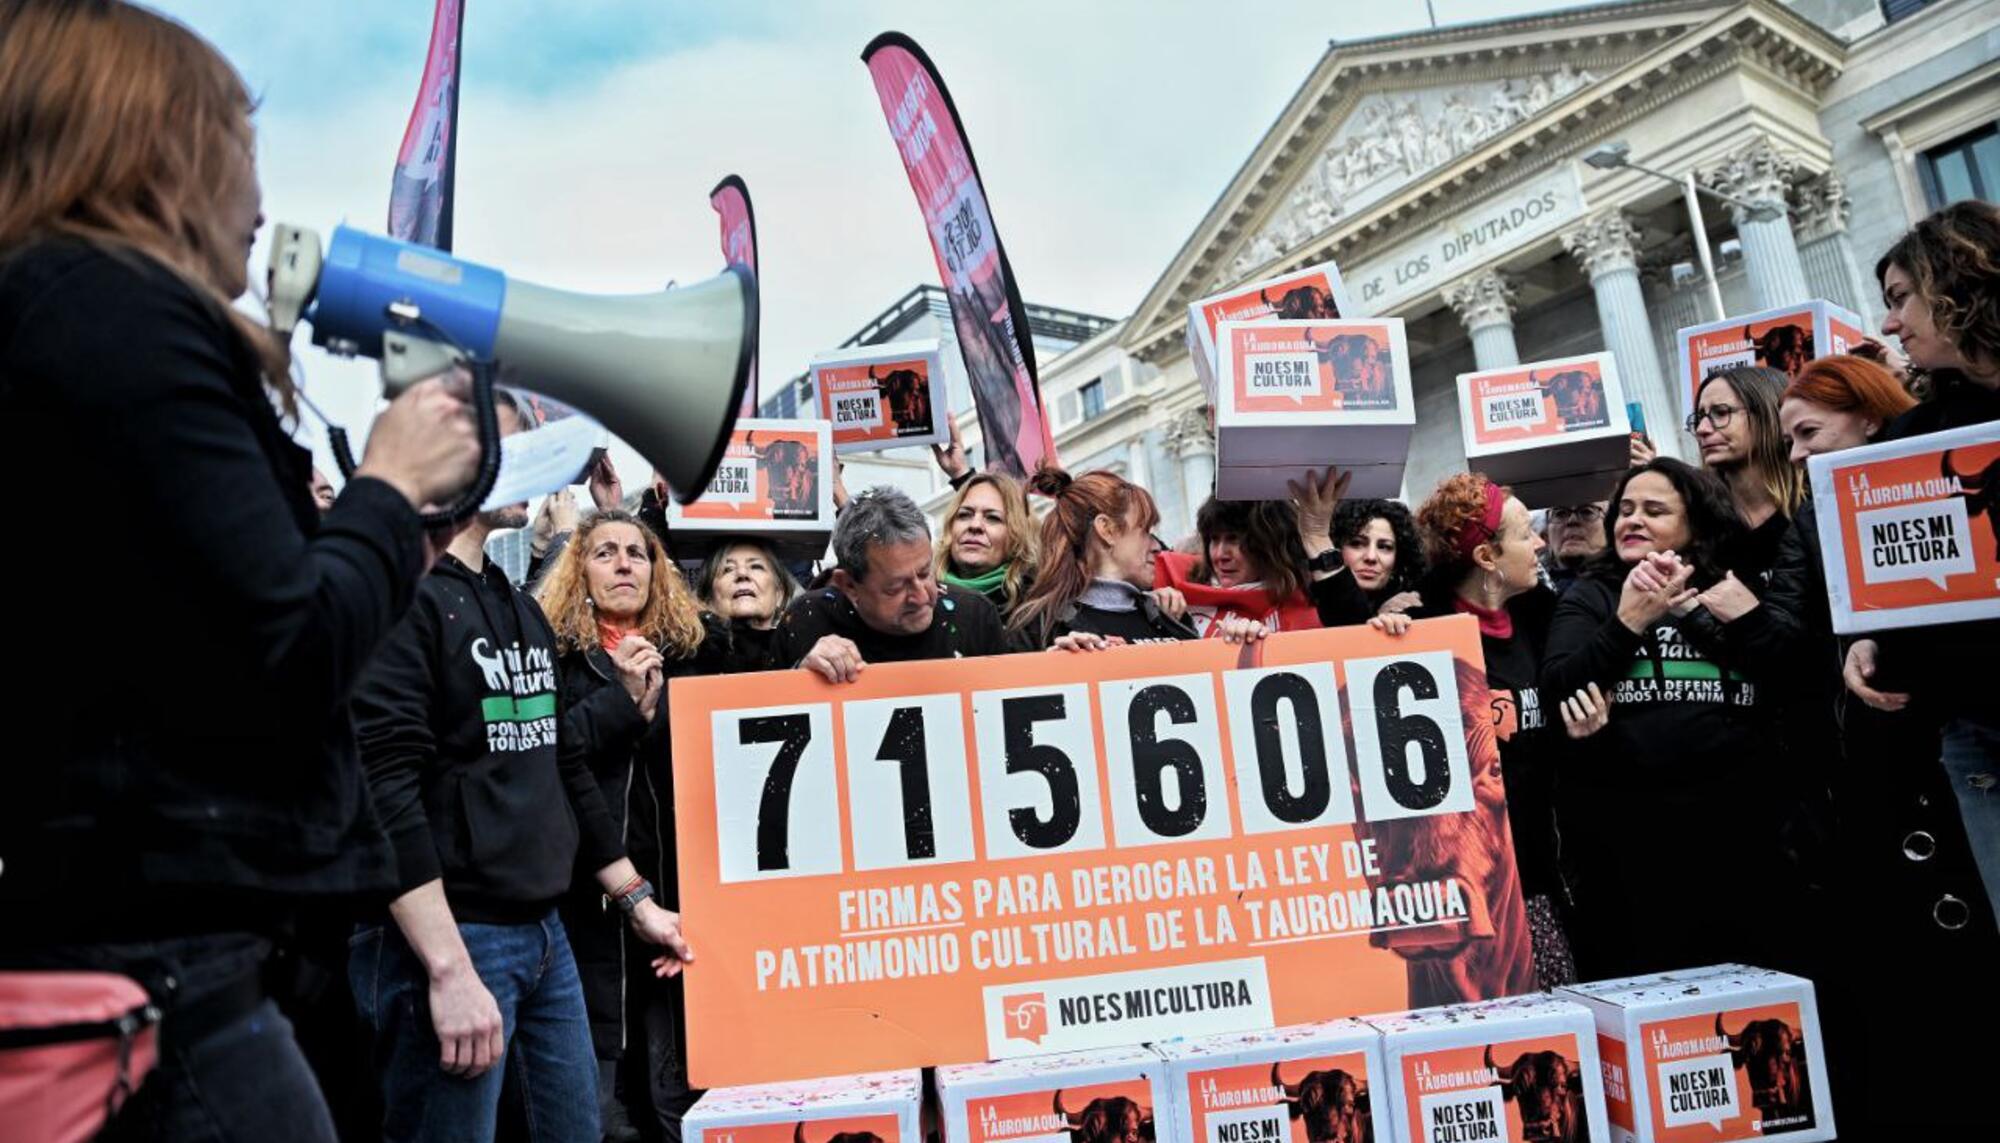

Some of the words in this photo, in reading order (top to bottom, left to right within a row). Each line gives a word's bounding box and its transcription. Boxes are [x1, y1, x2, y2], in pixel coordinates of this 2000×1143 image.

[1361, 276, 1385, 302] DE
[1394, 254, 1431, 286] LOS
[1441, 190, 1557, 263] DIPUTADOS
[1243, 332, 1257, 346] LA
[1253, 373, 1312, 388] CULTURA
[837, 409, 877, 422] CULTURA
[1489, 410, 1538, 423] CULTURA
[706, 479, 749, 493] ULTURA
[1849, 472, 1870, 491] LA
[1852, 475, 1963, 508] TAUROMAQUIA
[1872, 538, 1960, 568] CULTURA
[1640, 679, 1659, 691] LA
[1665, 680, 1722, 692] DEFENS
[1610, 691, 1652, 703] ODOS
[839, 881, 964, 931] FIRMAS
[973, 872, 1063, 918] PARA
[1072, 856, 1217, 908] DEROGAR
[1225, 850, 1267, 892] LA
[1274, 843, 1330, 886] LEY
[1342, 839, 1381, 878] DE
[755, 933, 961, 991] PATRIMONIO
[970, 915, 1137, 970] CULTURAL
[1145, 910, 1186, 951] DE
[1195, 905, 1237, 946] LA
[1244, 879, 1467, 941] TAUROMAQUIA
[1651, 1028, 1668, 1045] LA
[1654, 1034, 1730, 1059] TAUROMAQUIA
[1414, 1060, 1431, 1077] LA
[1200, 1077, 1217, 1094] LA
[1416, 1067, 1500, 1092] TAUROMAQUIA
[1202, 1085, 1287, 1109] TAUROMAQUIA
[1670, 1088, 1731, 1114] CULTURA
[980, 1105, 998, 1122] LA
[981, 1113, 1069, 1137] TAUROMAQUIA
[1432, 1120, 1499, 1143] CULTURA
